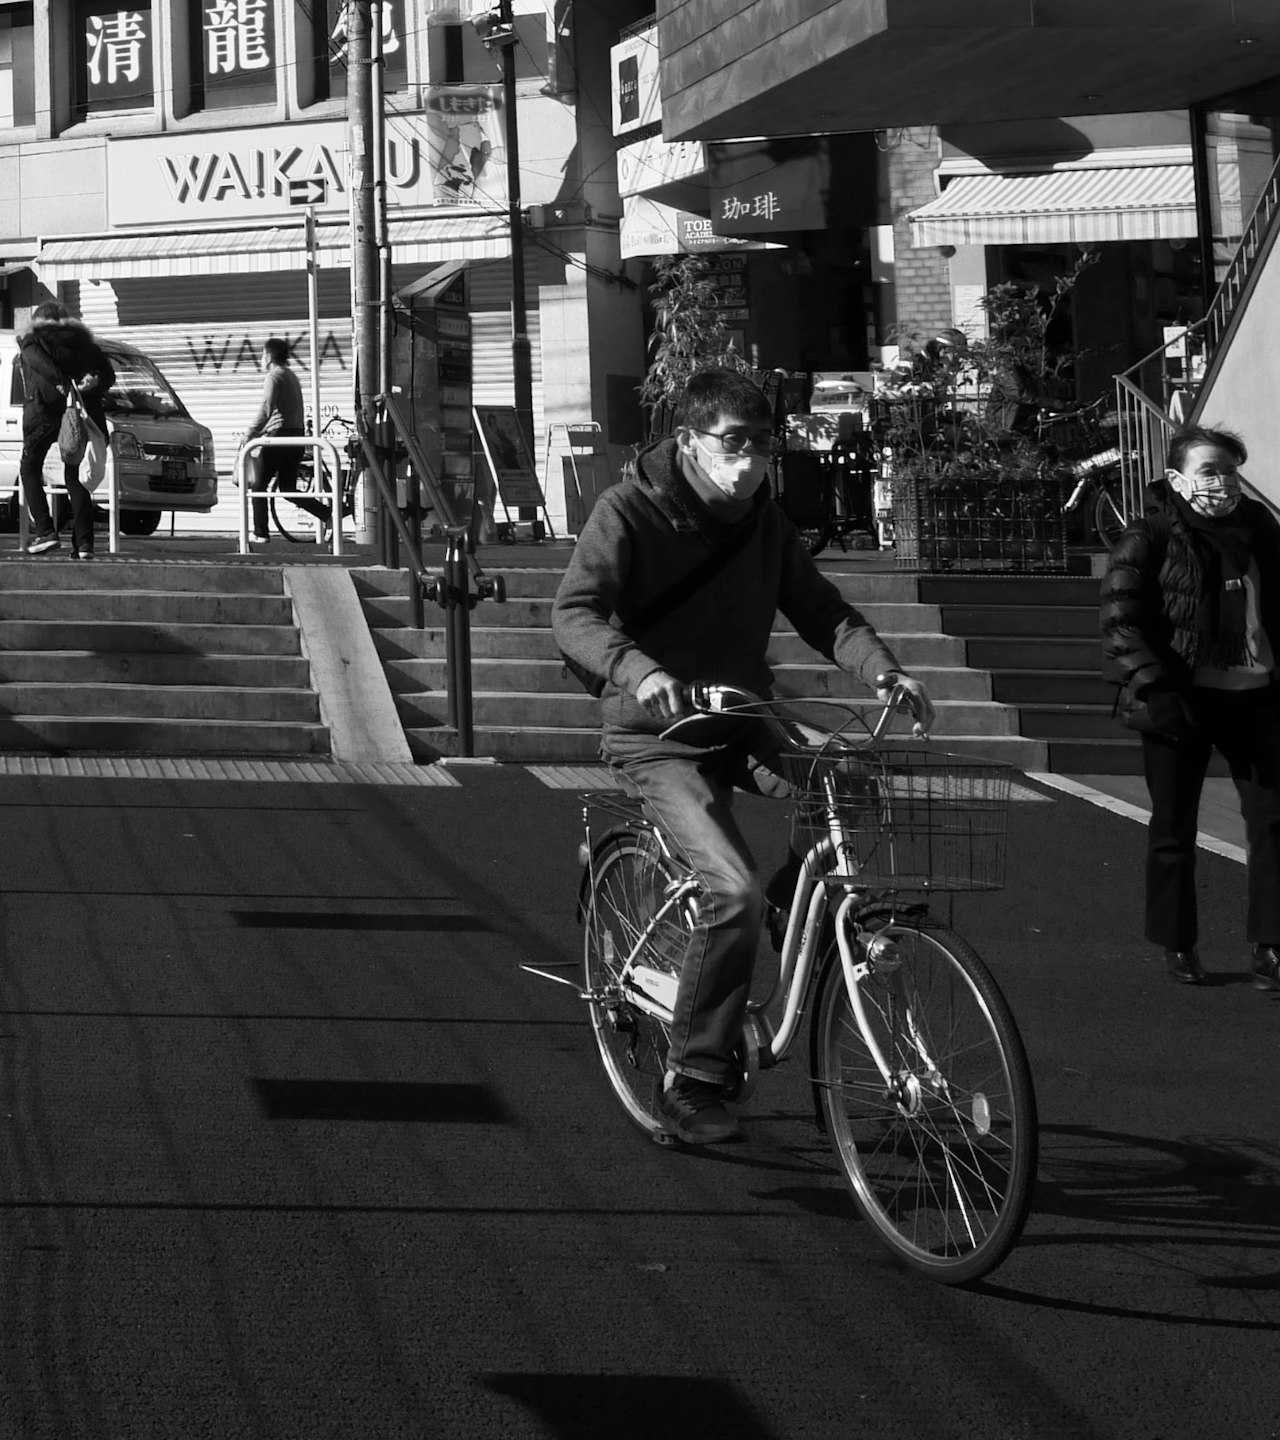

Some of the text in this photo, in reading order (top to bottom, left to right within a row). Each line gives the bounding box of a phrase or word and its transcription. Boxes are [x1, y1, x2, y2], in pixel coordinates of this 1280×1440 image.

[159, 138, 418, 202] WA!KAU
[721, 191, 781, 222] 珈琲
[685, 232, 713, 240] ACADE
[187, 331, 347, 375] WAKA
